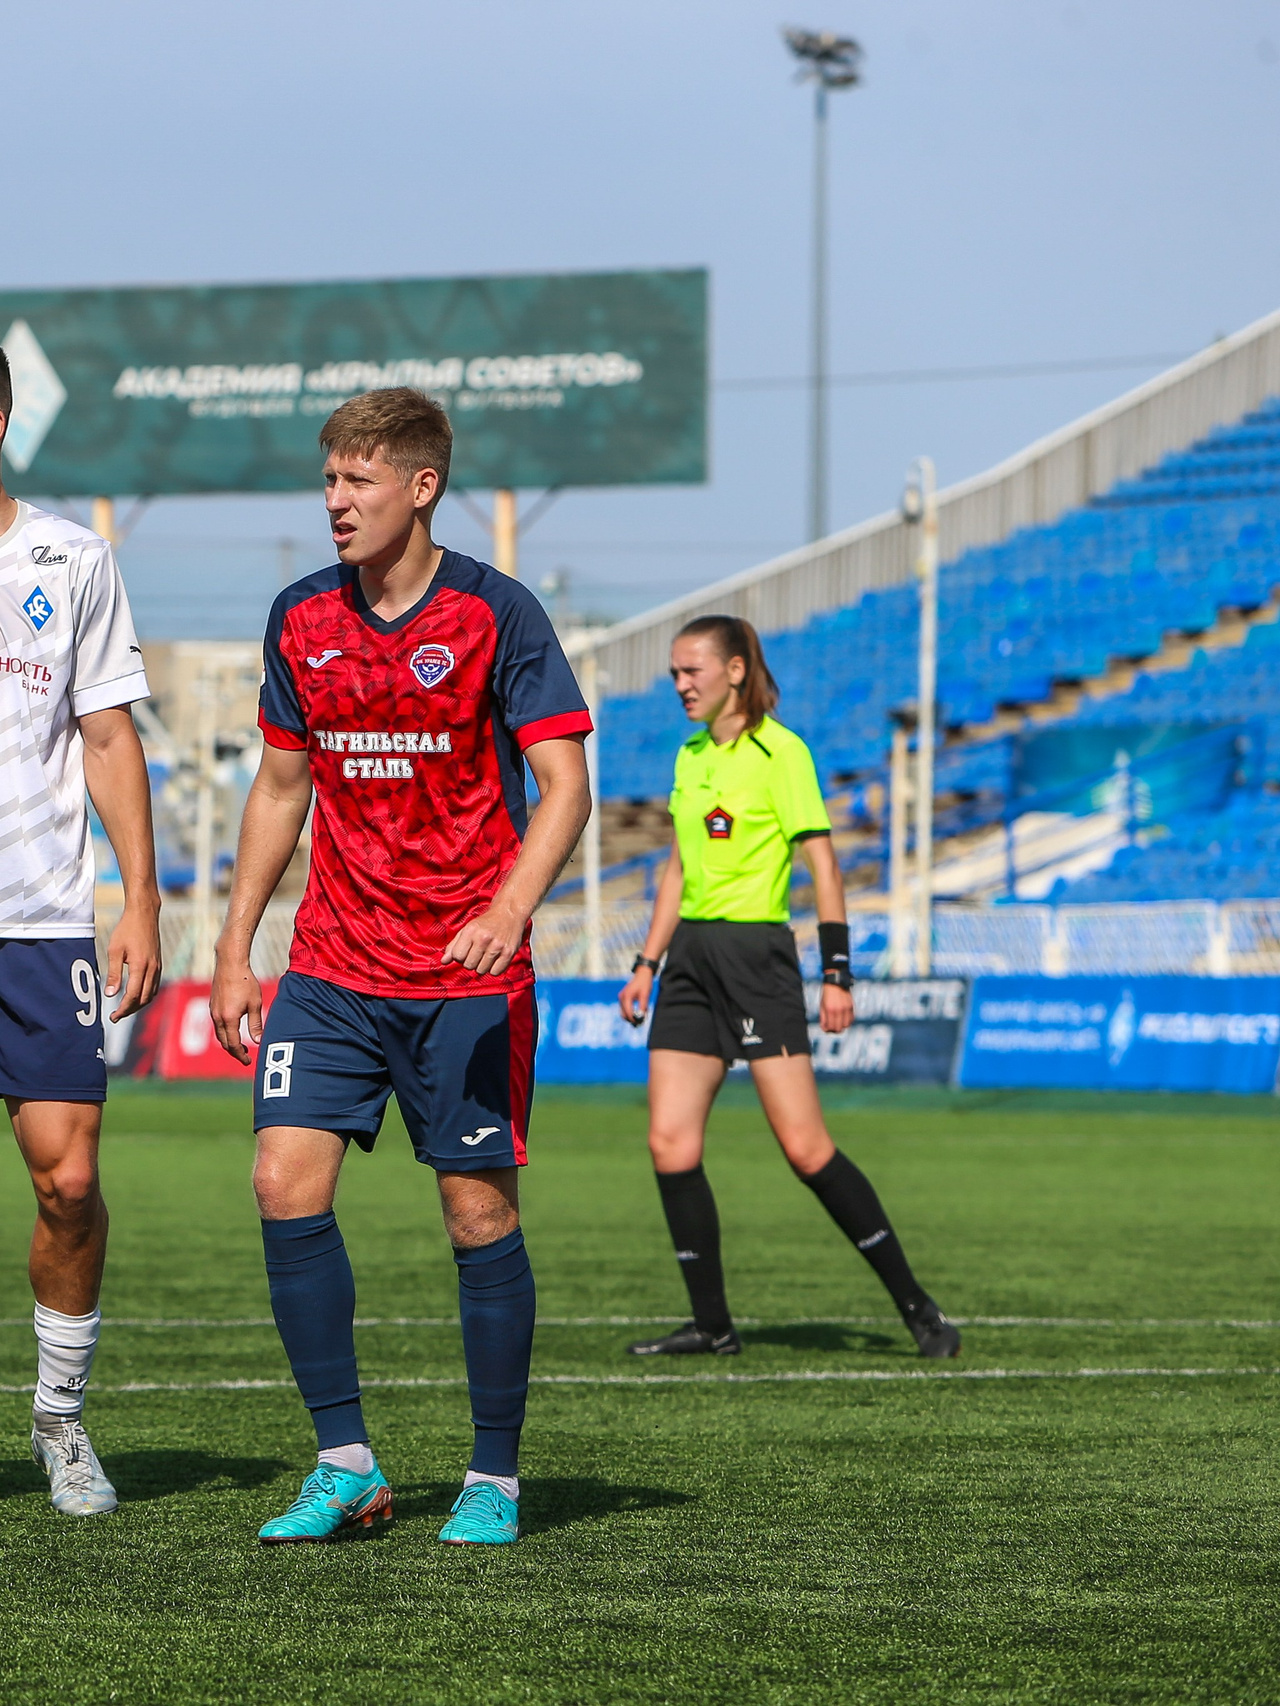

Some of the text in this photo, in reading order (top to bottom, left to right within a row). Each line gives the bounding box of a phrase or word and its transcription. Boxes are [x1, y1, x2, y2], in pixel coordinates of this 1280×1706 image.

[113, 364, 302, 400] АКАДЕМИЯ
[314, 730, 451, 752] ТАГИЛЬСКАЯ
[343, 758, 414, 778] СТАЛЬ
[70, 957, 100, 1027] 9
[807, 1023, 893, 1073] ССИЯ
[263, 1042, 295, 1099] 8
